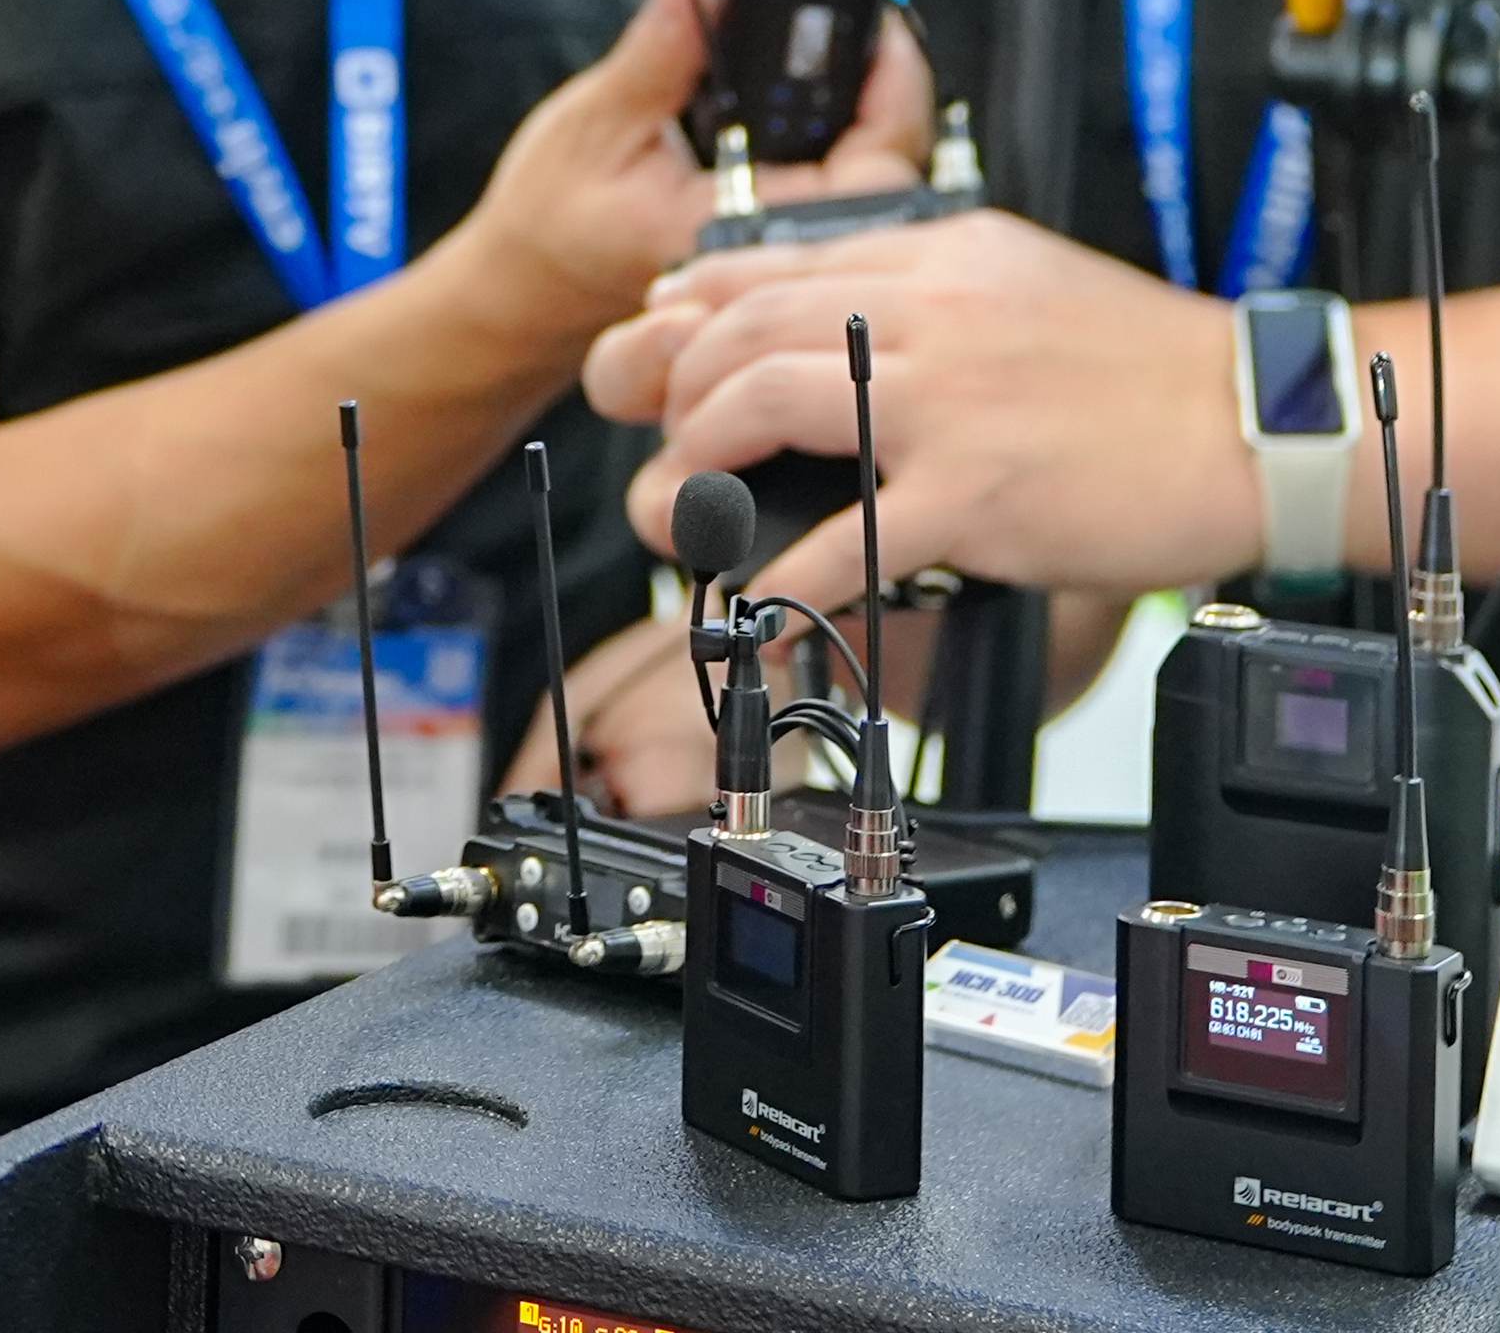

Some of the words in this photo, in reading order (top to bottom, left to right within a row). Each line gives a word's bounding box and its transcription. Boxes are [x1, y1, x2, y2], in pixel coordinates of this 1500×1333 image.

[1210, 996, 1294, 1031] 618.225
[1267, 1215, 1323, 1237] bodypack
[1324, 1227, 1388, 1250] transmitter
